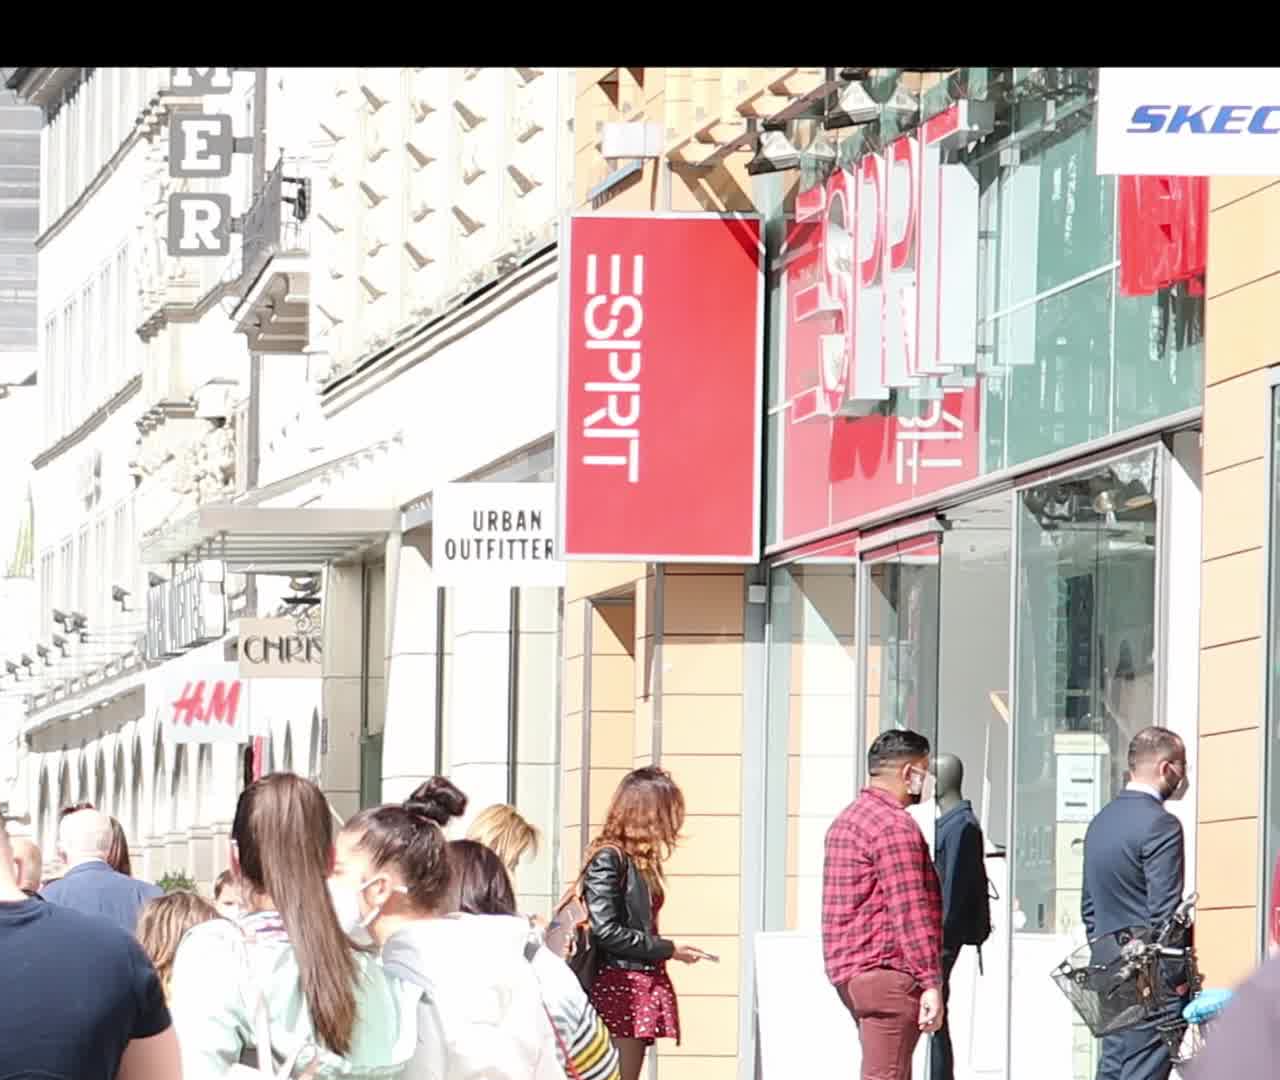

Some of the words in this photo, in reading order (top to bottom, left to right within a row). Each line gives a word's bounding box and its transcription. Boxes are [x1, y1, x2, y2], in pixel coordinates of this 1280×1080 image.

[1126, 105, 1280, 134] SKEC
[583, 255, 644, 482] ESPRIT
[473, 509, 542, 532] URBAN
[445, 538, 553, 560] OUTFITTER
[172, 679, 242, 727] H&M
